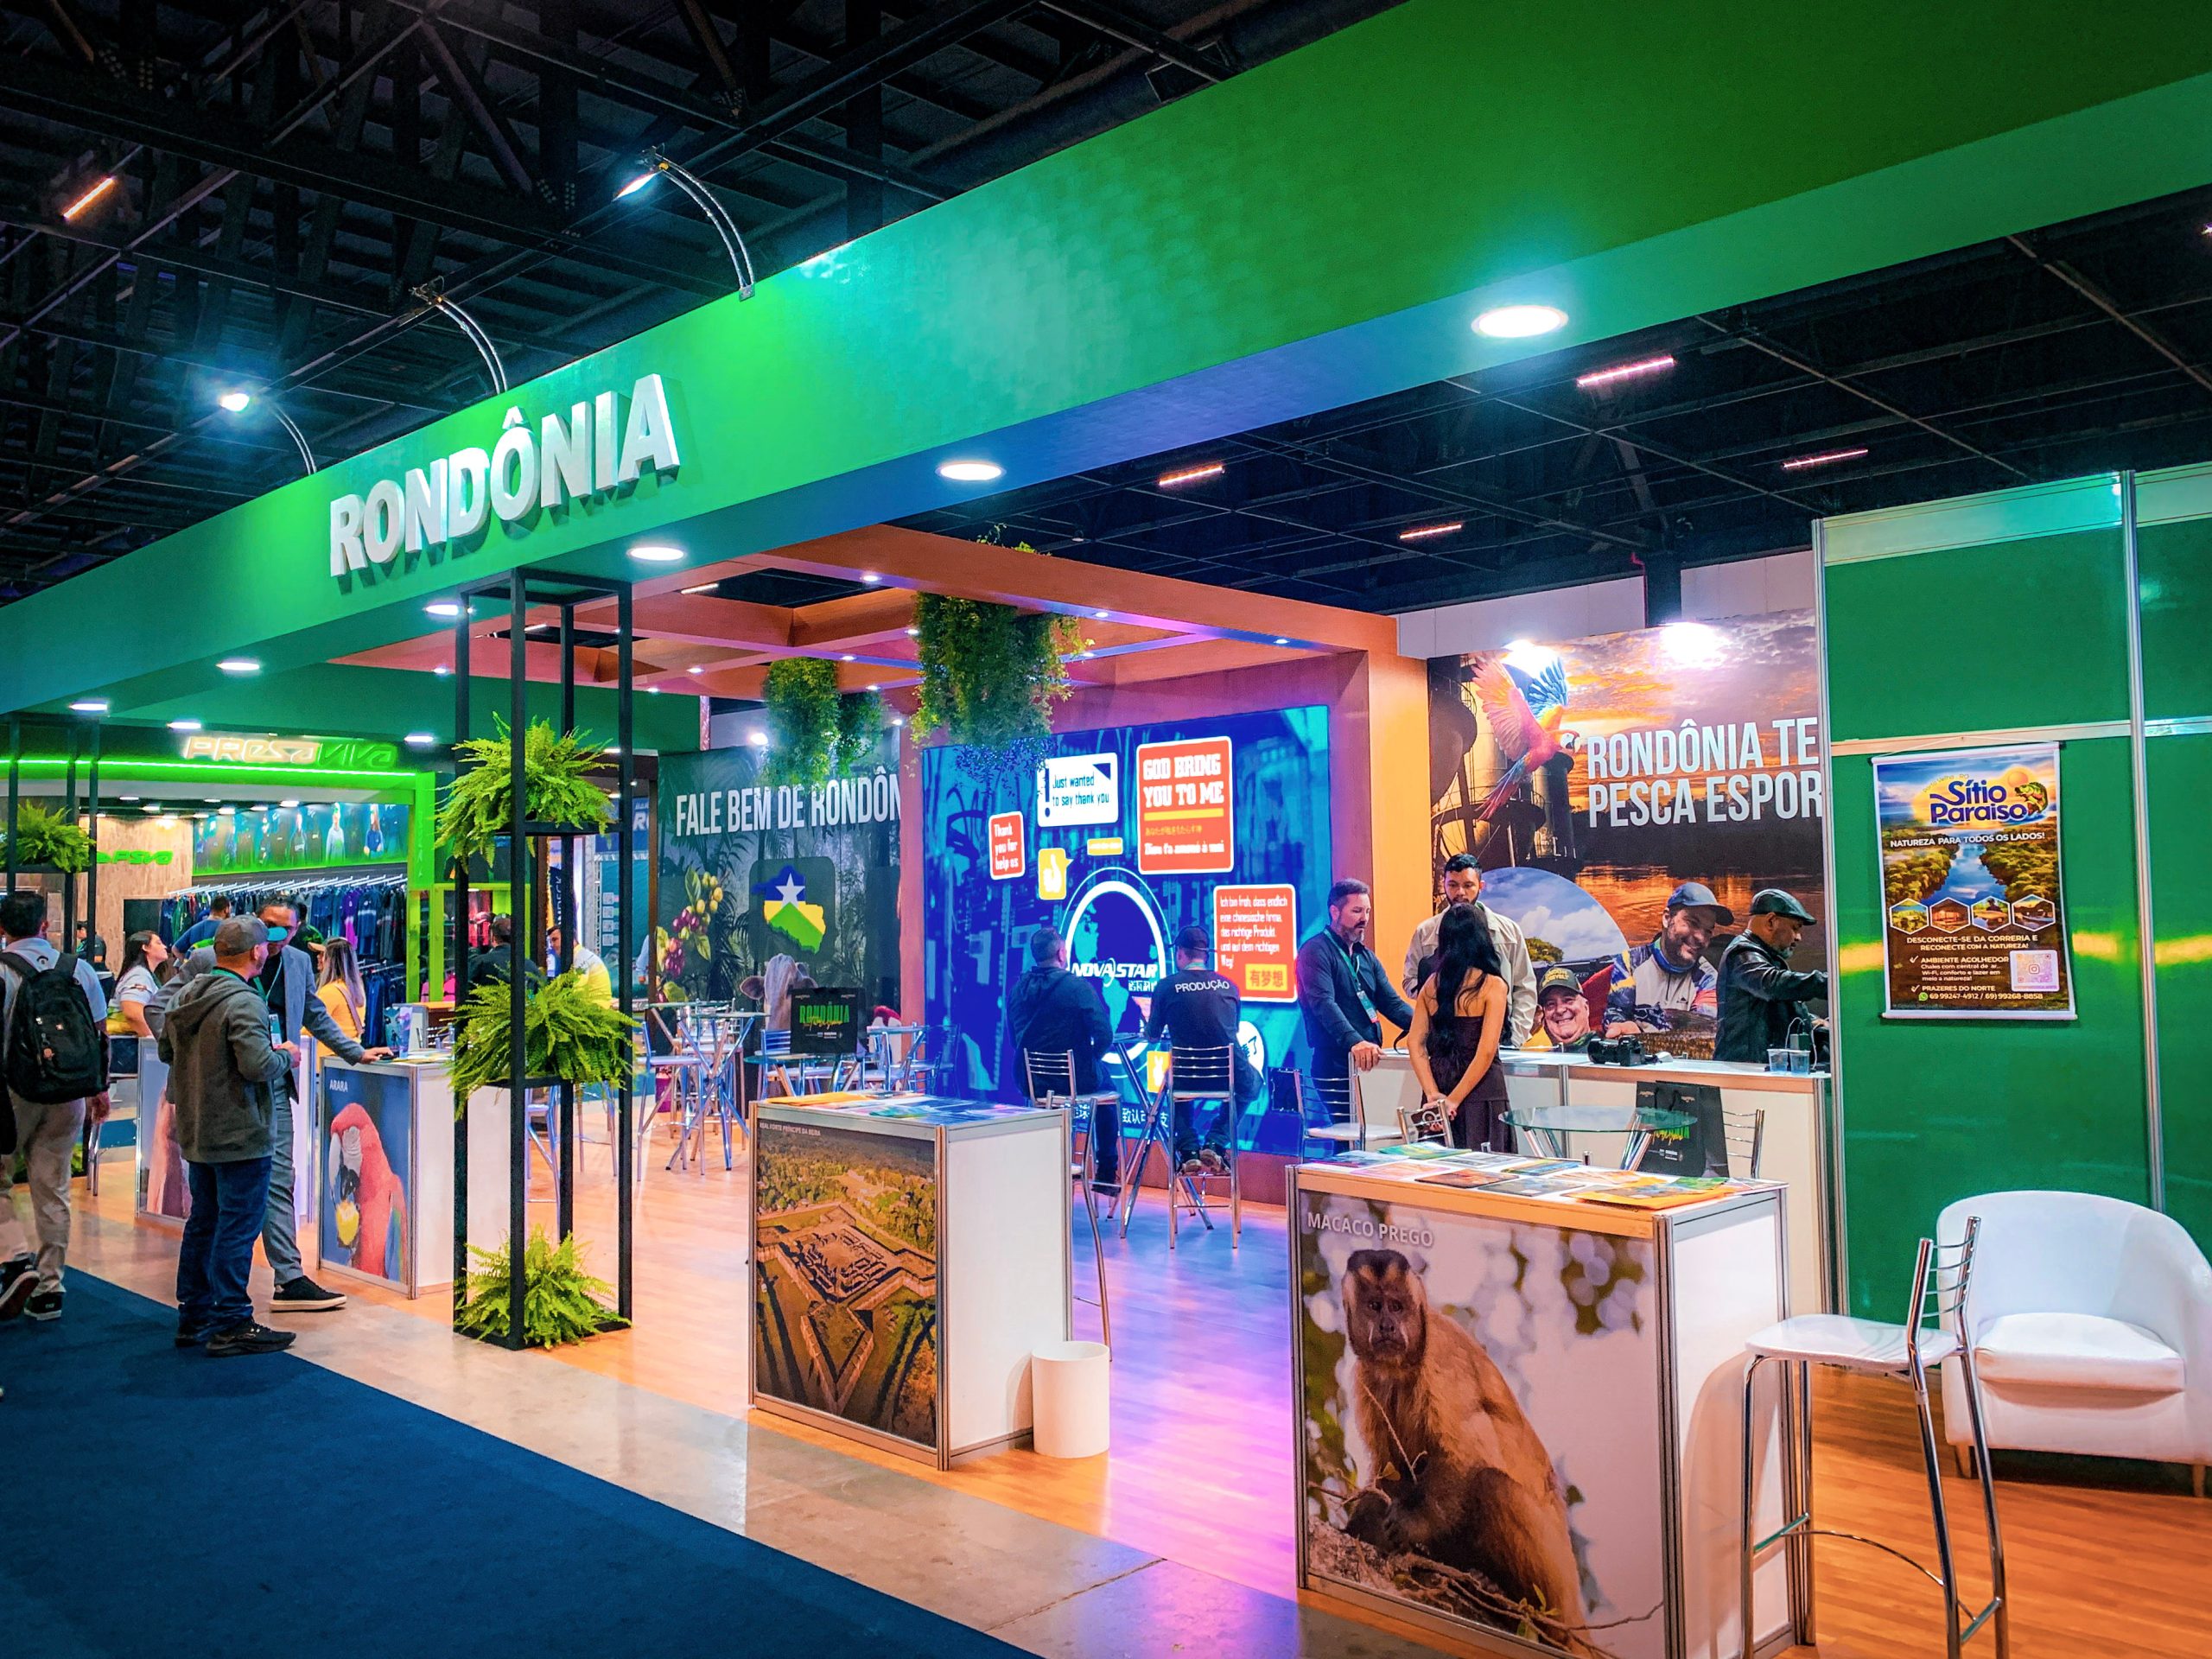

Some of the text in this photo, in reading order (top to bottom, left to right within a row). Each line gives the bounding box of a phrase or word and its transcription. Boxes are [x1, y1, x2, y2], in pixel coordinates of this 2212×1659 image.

[330, 373, 680, 577] RONDÔNIA
[1587, 717, 1819, 779] RONDÔNIA TE
[1143, 753, 1221, 780] GOD BRING
[1052, 772, 1095, 789] Just wanted
[1052, 791, 1109, 808] to say thank you
[1143, 781, 1224, 808] YOU TO ME
[1587, 770, 1822, 828] PESCA ESPOR
[1929, 779, 2007, 805] Sítio
[676, 791, 722, 836] FALE
[728, 786, 772, 833] BEM
[778, 785, 804, 830] DE
[1930, 803, 2027, 823] Paraiso
[994, 824, 1014, 836] Thank
[1891, 838, 1936, 848] NATUREZA
[1938, 836, 1961, 845] PARA
[1963, 835, 1994, 844] TODOS
[2010, 832, 2045, 841] LADOS!
[995, 839, 1018, 855] you for
[995, 858, 1019, 871] help us
[1174, 979, 1230, 993] PRODUÇÃO
[799, 1001, 850, 1024] RONDÔNIA
[329, 1079, 348, 1092] ARARA
[1307, 1211, 1433, 1247] MACACO PREGO
